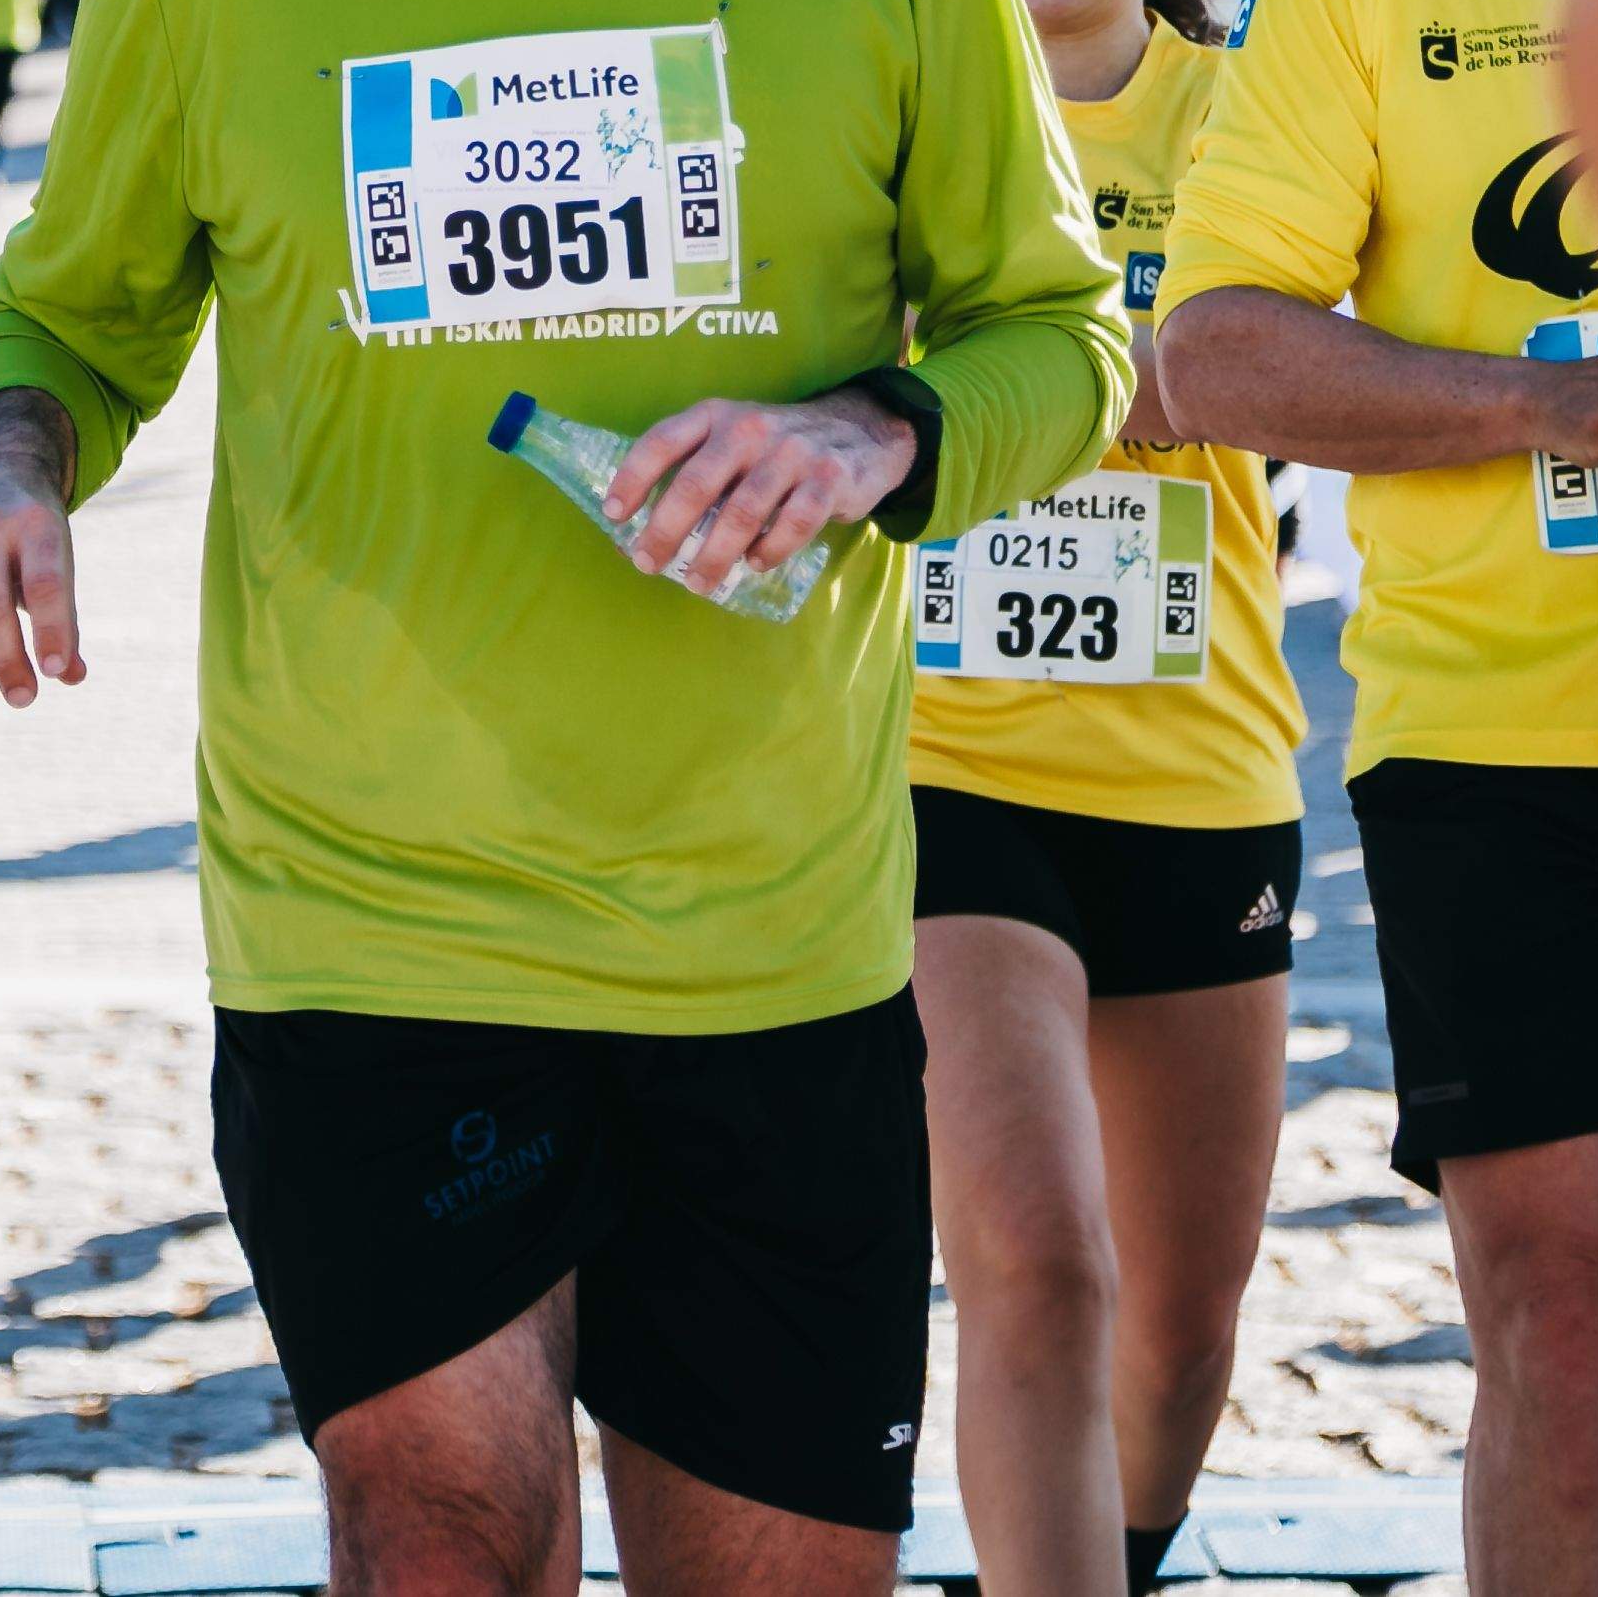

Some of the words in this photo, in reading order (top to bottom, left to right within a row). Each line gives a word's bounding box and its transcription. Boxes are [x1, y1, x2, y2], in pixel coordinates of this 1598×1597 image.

[1463, 39, 1494, 55] San
[1465, 58, 1485, 72] de
[1489, 53, 1512, 67] los
[492, 66, 640, 106] MetLife
[465, 139, 581, 184] 3032
[443, 196, 650, 296] 3951
[534, 312, 660, 340] MADRID
[1030, 495, 1147, 521] MetLife
[989, 533, 1079, 570] 0215
[996, 591, 1119, 663] 323
[423, 1132, 556, 1219] SETPOINT
